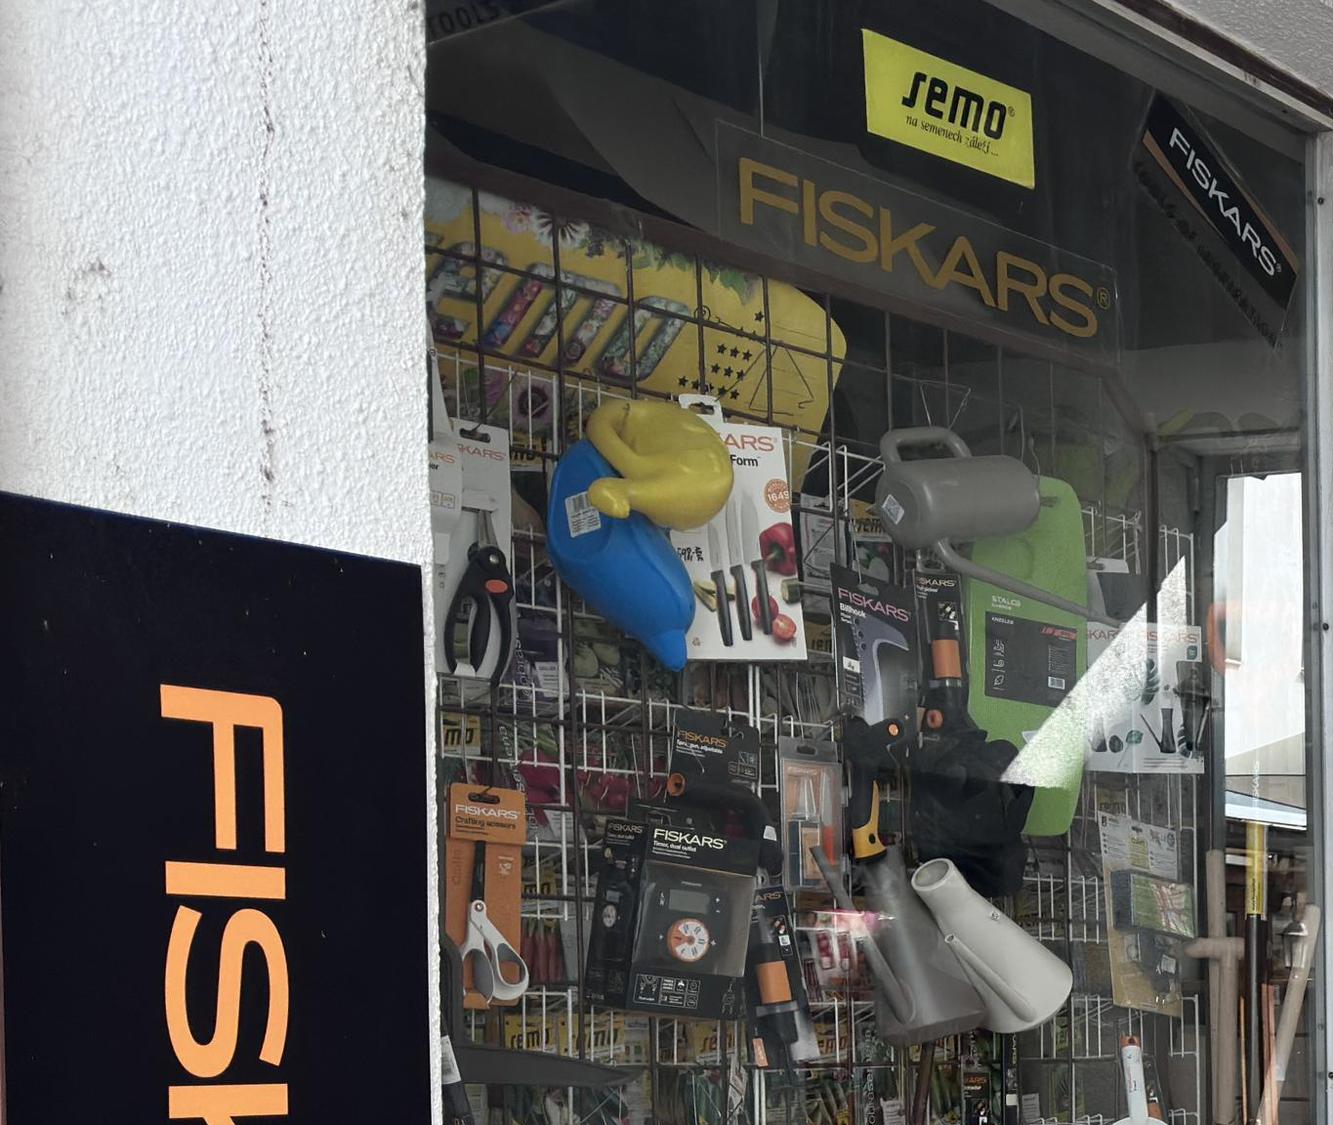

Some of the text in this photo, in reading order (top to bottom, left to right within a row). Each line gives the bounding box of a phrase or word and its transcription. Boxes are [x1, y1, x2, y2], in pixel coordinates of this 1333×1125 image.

[921, 119, 962, 144] semenech
[455, 804, 519, 820] FISKARS
[455, 814, 485, 827] Crafting
